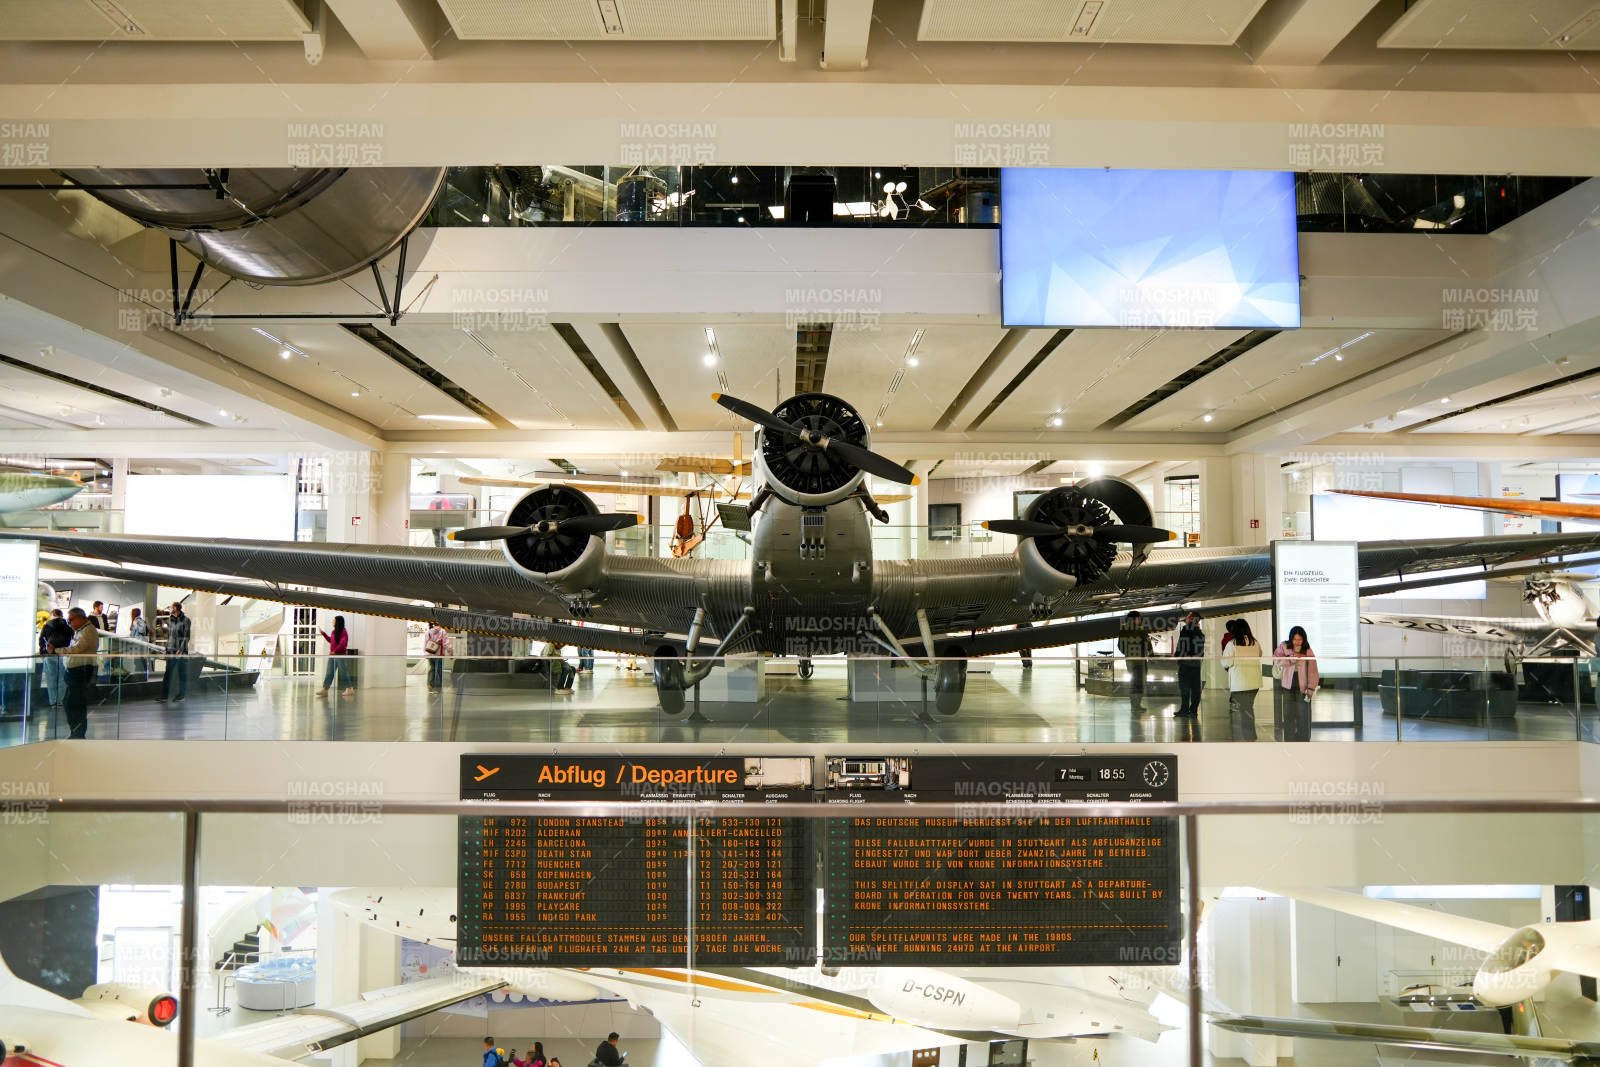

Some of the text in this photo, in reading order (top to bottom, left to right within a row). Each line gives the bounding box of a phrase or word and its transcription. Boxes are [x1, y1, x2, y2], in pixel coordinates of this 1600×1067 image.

[538, 765, 738, 787] Abflug / Departure
[1061, 768, 1066, 780] 7
[1100, 769, 1125, 780] 18 55
[538, 818, 571, 828] LONDON
[854, 818, 870, 826] DAS
[876, 818, 918, 826] DEUTSCHE
[925, 818, 956, 826] MUSEUM
[1017, 818, 1032, 826] SIE
[1055, 818, 1071, 826] DER
[1077, 818, 1151, 826] LUFTFAHRTHALLE
[537, 828, 581, 838] ALDERAAN
[538, 838, 586, 848] BARCELONA
[854, 838, 1161, 848] DIESE FALLBLATTTAFEL WURDE STUTTGART ALS ABFLUGANZEIGE
[536, 850, 565, 858] DEATH
[570, 850, 592, 858] STAR
[854, 848, 1152, 858] EINGESETZT UND WAR DORT UEBER ZWANZIG JAHRE BETRIEB.
[538, 860, 581, 868] MUENCHEN
[854, 860, 887, 868] GEBAUT
[892, 860, 919, 868] WURDE
[925, 860, 941, 868] SIE
[946, 860, 962, 868] VON
[968, 860, 995, 868] KRONE
[537, 870, 591, 880] KOPENHAGEN
[538, 880, 580, 890] BUDAPEST
[856, 880, 1152, 890] THIS SPLITFLAP DISPLAY SAT STUTTGART DEPARTURE-
[537, 892, 585, 900] FRANKFURT
[853, 890, 883, 900] BOARD
[904, 890, 952, 900] OPERATION
[958, 890, 974, 900] FOR
[979, 890, 1001, 900] OVER
[1008, 890, 1039, 900] TWENTY
[1120, 890, 1146, 900] BUILT
[854, 902, 880, 910] KRONE
[538, 912, 570, 922] INDIGO
[575, 912, 596, 922] PARK
[482, 934, 515, 942] UNSERE
[520, 934, 601, 942] FALLBLATTMODULE
[608, 934, 646, 942] STAMMEN
[651, 934, 667, 942] AUS
[849, 932, 866, 942] OUR
[872, 932, 946, 942] SPLITFLAPUNITS
[953, 932, 974, 942] WERE
[980, 932, 1000, 942] MADE
[1024, 932, 1040, 942] THE
[482, 944, 497, 954] SIE
[504, 944, 536, 954] LIEFEN
[559, 944, 607, 954] FLUGHAFEN
[613, 944, 629, 954] 24H
[651, 944, 667, 954] TAG
[706, 944, 728, 954] TAGE
[733, 944, 748, 954] DIE
[850, 944, 871, 952] THEY
[876, 944, 897, 952] WERE
[904, 944, 941, 952] RUNNING
[997, 944, 1012, 952] THE
[902, 979, 966, 1006] D-CSPN
